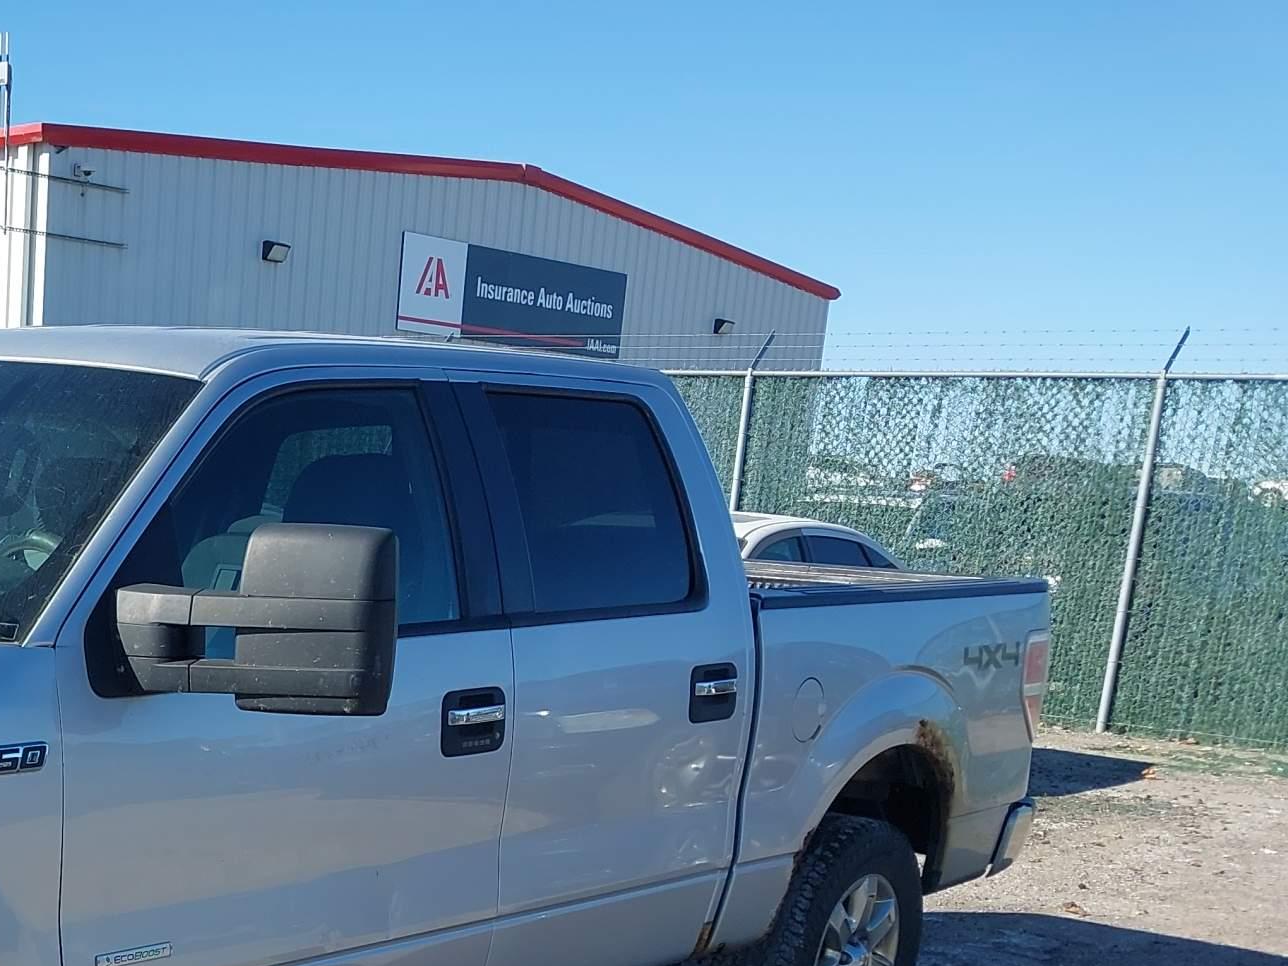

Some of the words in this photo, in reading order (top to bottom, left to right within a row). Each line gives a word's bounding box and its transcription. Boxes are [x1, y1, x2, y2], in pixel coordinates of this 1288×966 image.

[476, 276, 535, 306] Insurance
[537, 287, 563, 311] Auto
[565, 292, 613, 319] Auctions
